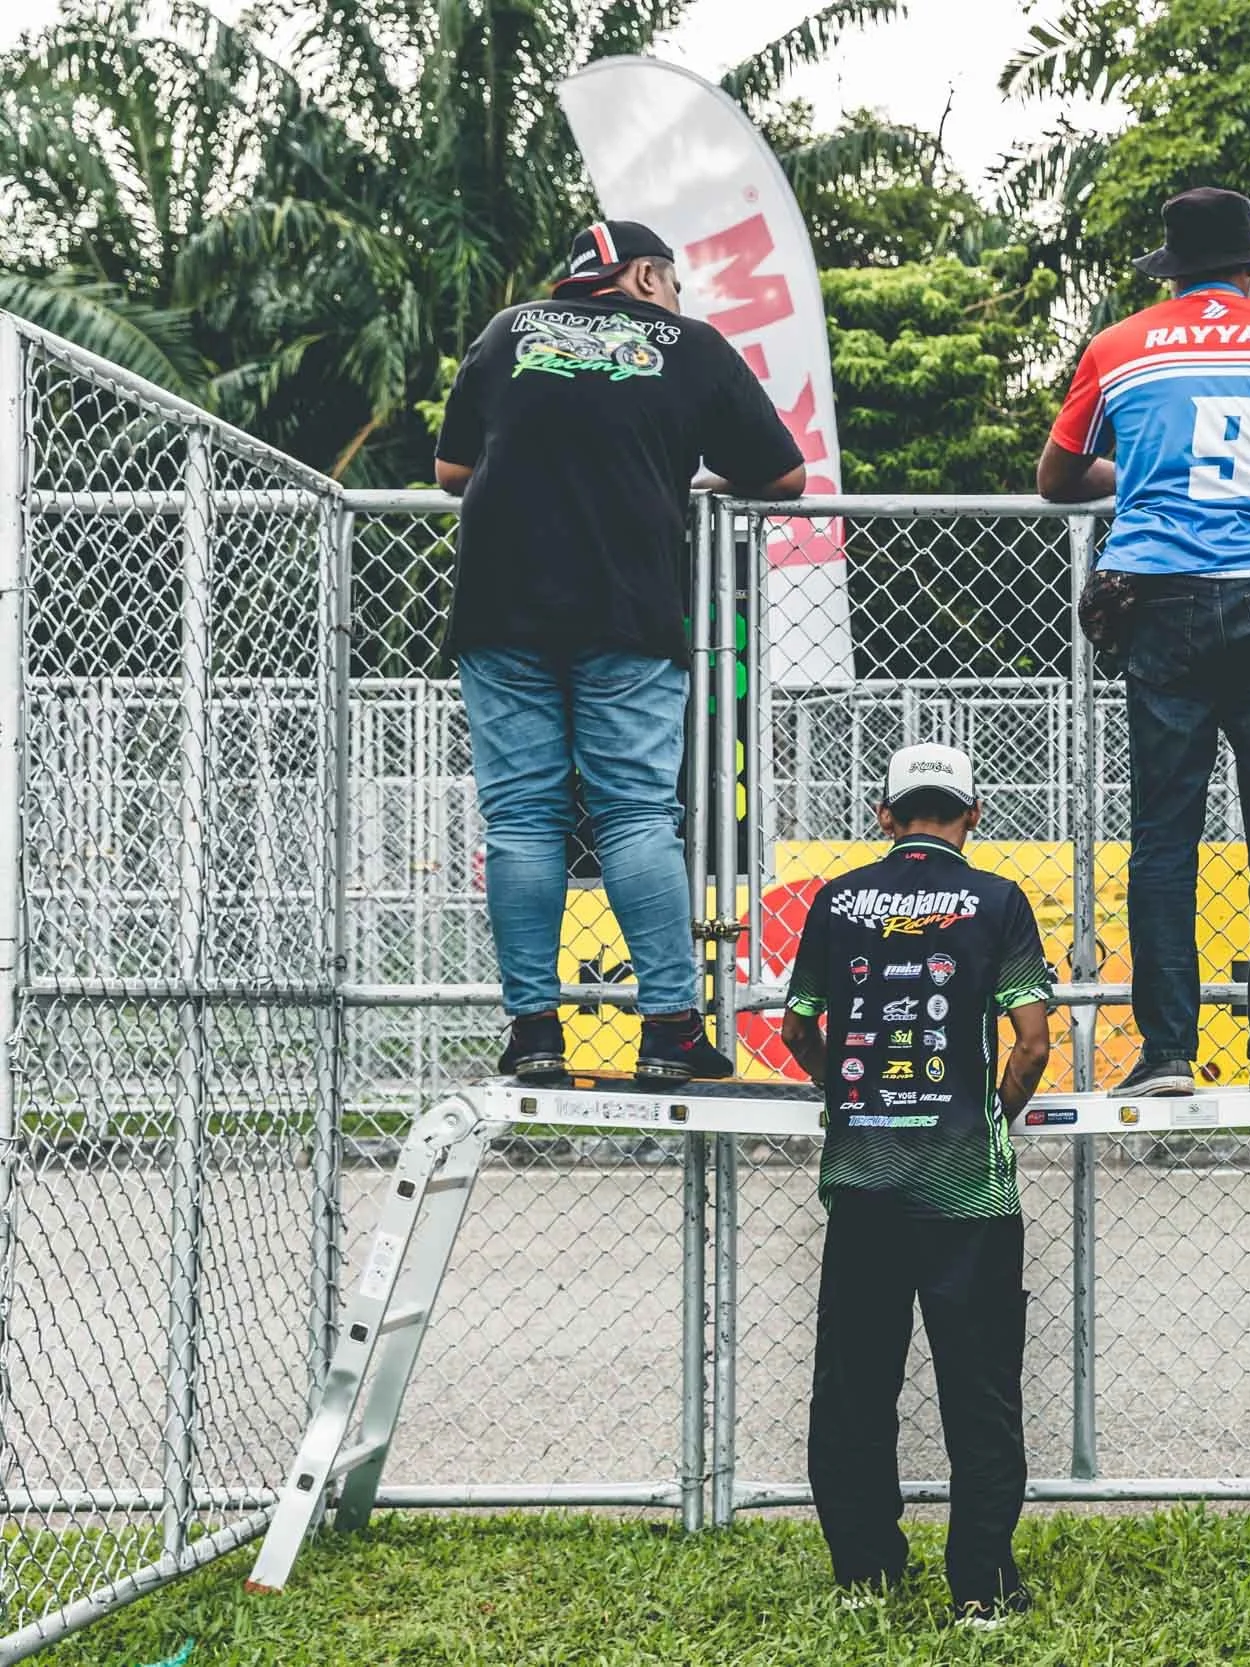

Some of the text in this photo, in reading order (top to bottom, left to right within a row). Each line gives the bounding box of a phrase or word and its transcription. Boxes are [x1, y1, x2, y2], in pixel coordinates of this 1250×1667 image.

[852, 889, 980, 918] Mctajam's
[882, 912, 976, 938] Racing
[897, 1091, 918, 1100] VOGE
